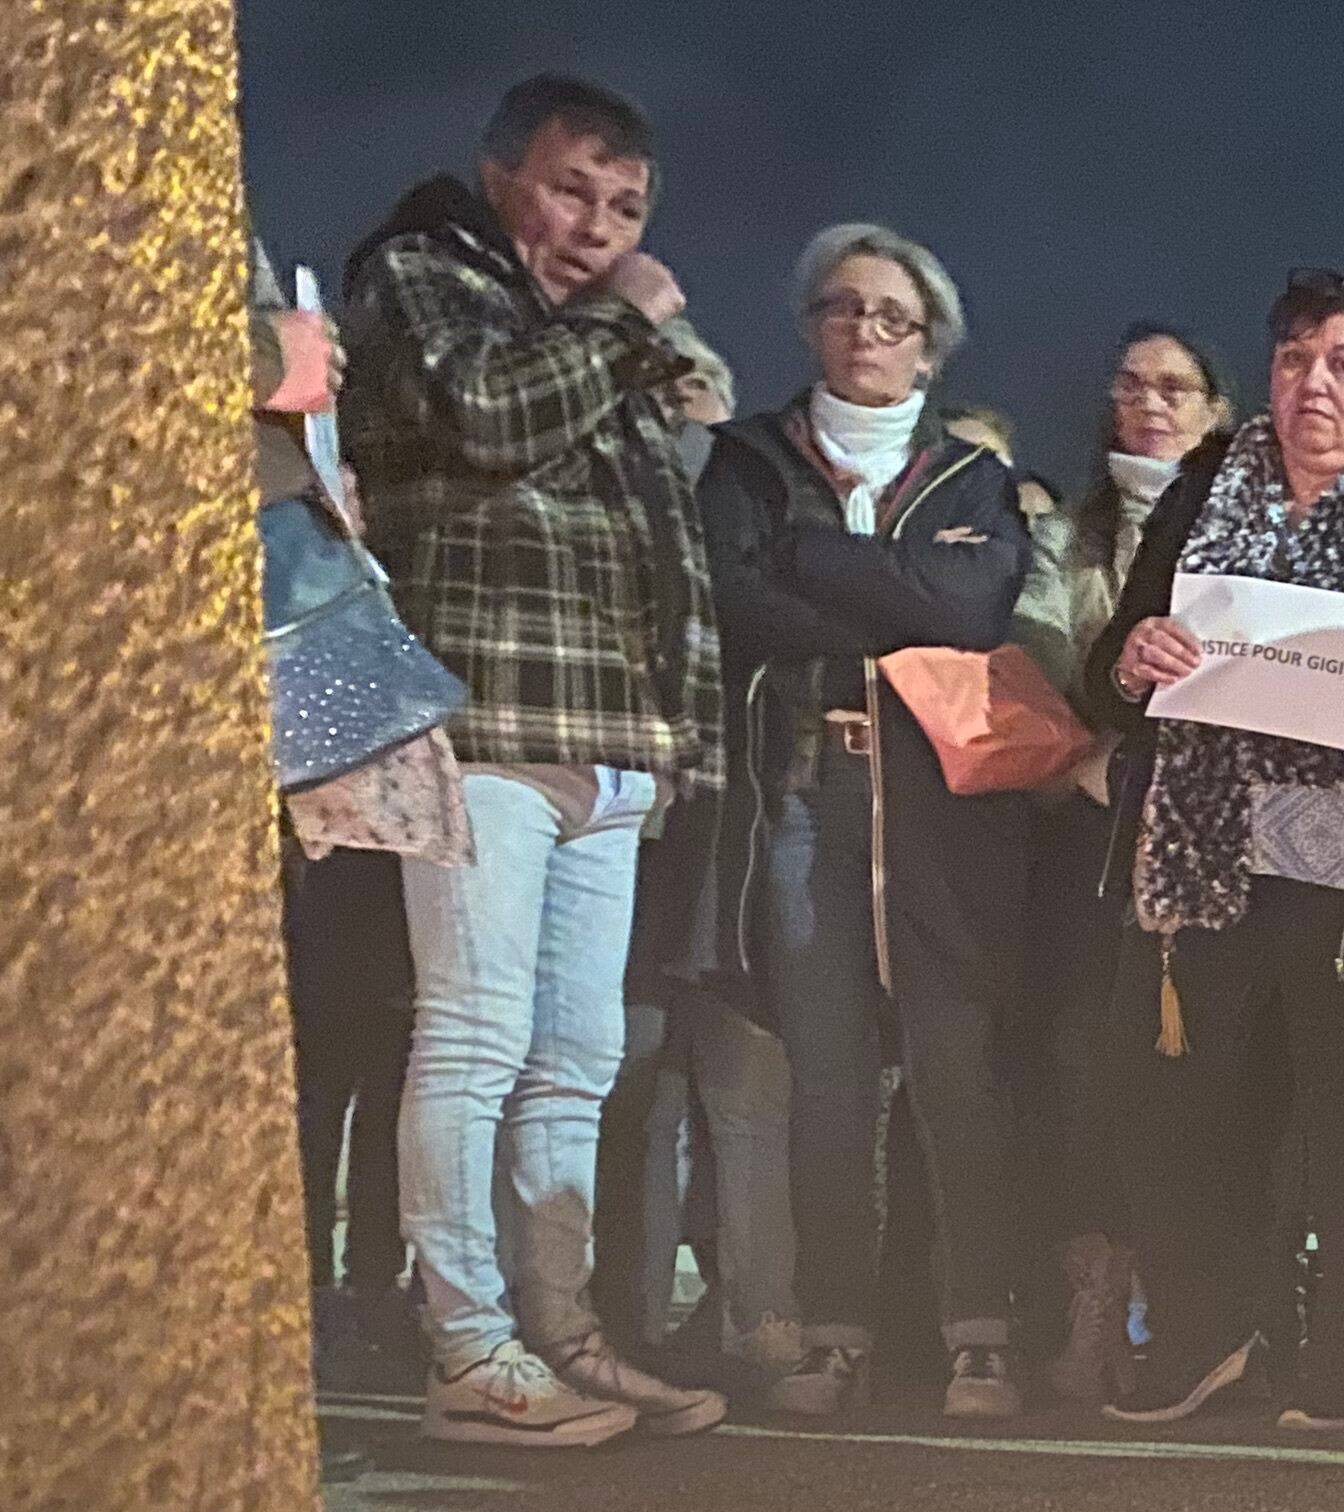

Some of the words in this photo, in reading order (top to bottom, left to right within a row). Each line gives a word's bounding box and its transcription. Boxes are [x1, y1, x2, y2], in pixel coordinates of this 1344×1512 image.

[1202, 639, 1249, 657] STICE
[1252, 644, 1302, 667] POUR
[1307, 655, 1344, 676] GIGI
